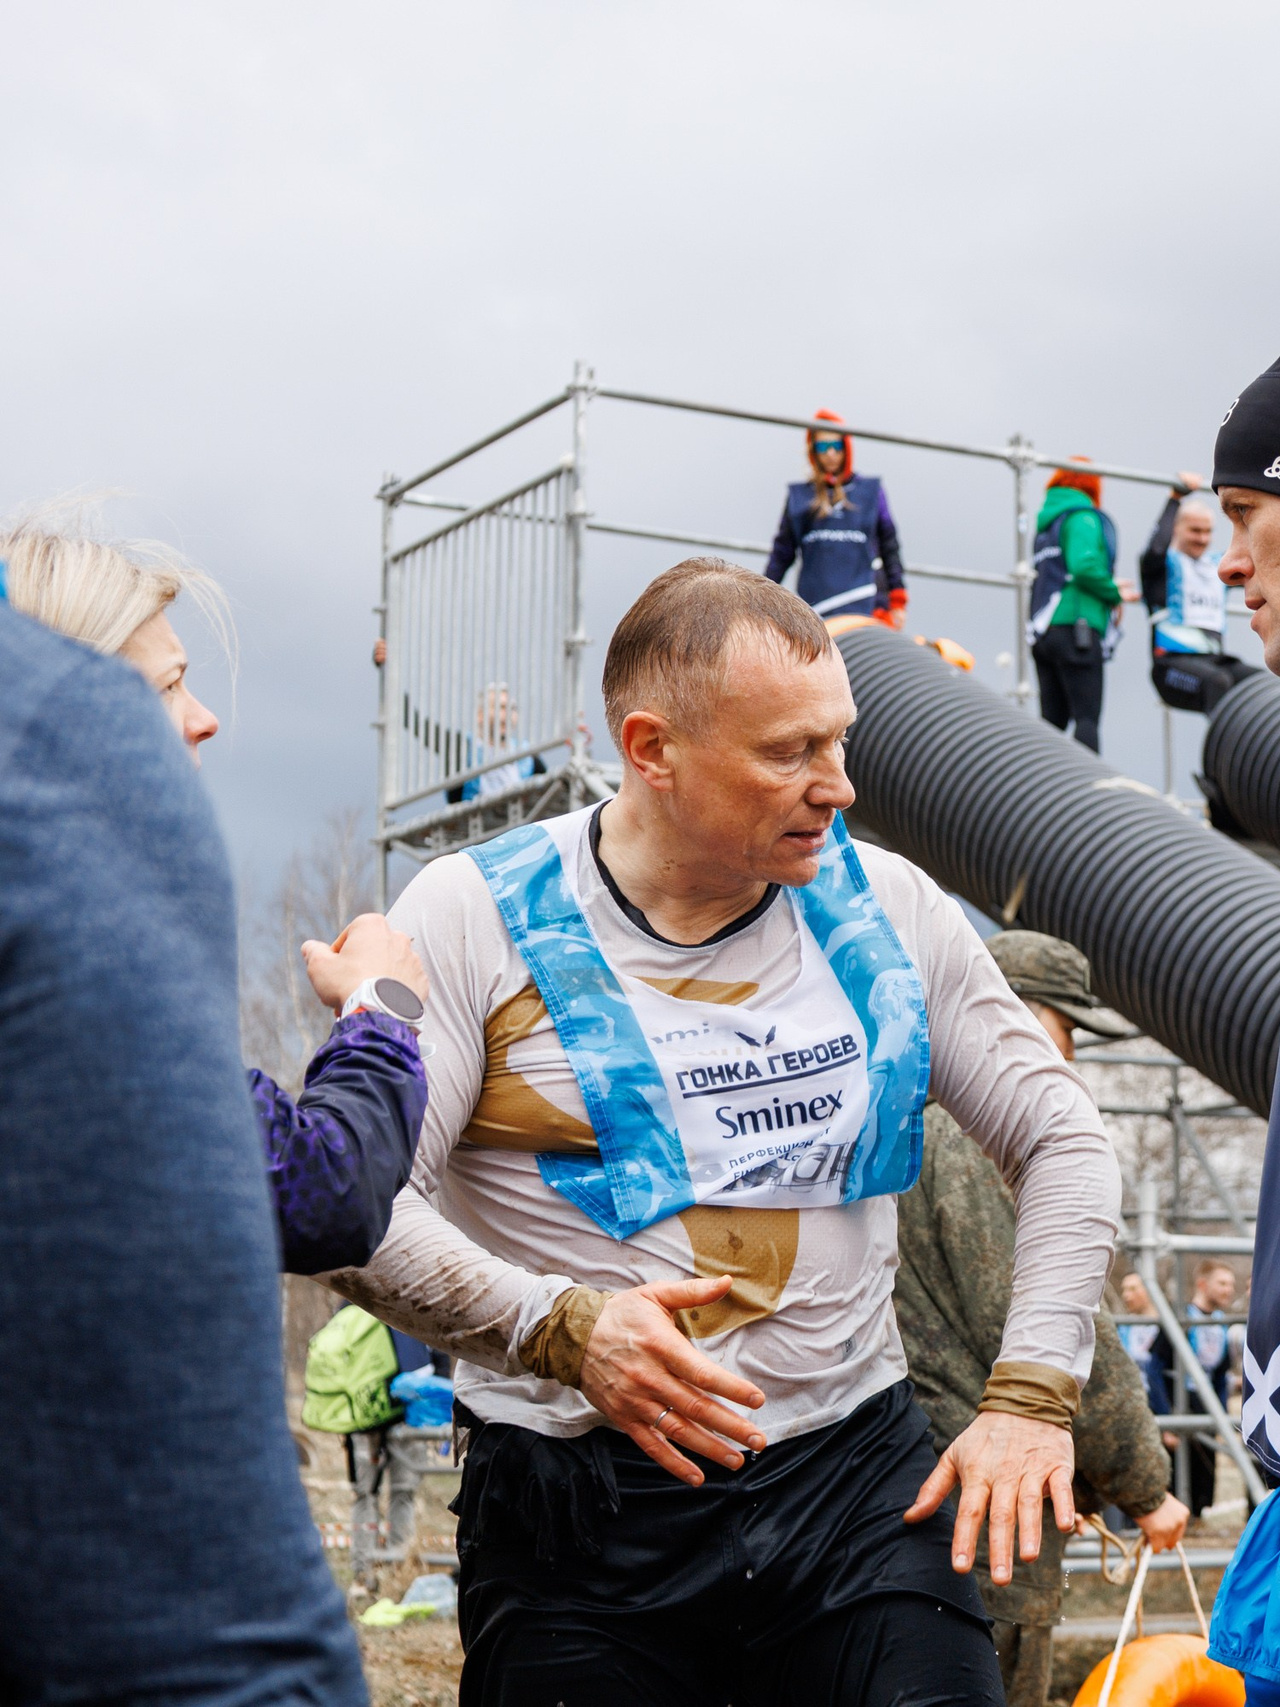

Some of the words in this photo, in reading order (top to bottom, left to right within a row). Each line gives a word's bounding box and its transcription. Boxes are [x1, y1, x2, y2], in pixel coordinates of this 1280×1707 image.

[675, 1059, 763, 1092] ГОНКА
[766, 1033, 858, 1077] ГЕРОЕВ
[715, 1088, 844, 1140] Sminex
